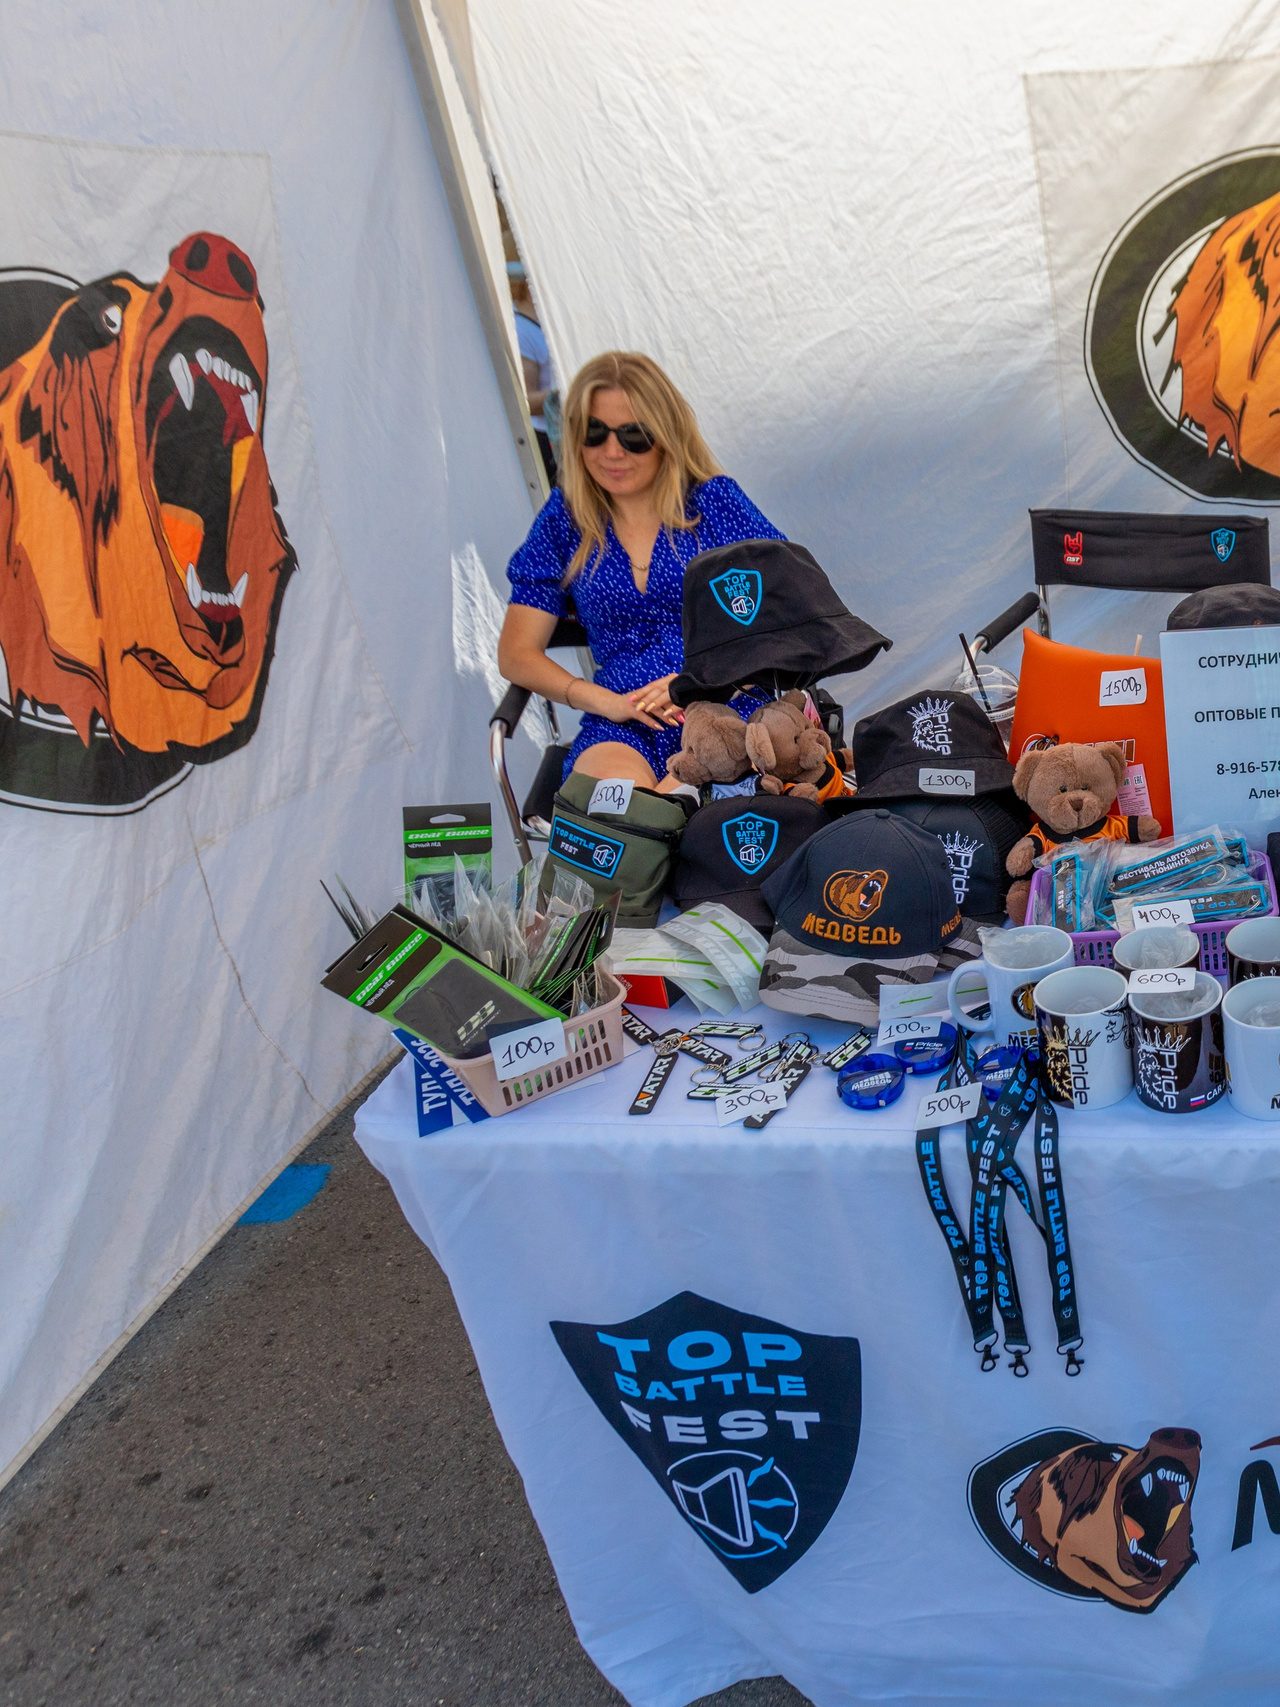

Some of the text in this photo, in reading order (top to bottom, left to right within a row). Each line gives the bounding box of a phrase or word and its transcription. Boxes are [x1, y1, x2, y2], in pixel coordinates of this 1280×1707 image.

[724, 574, 747, 585] TOP
[724, 582, 751, 594] BATTLE
[727, 588, 751, 599] FEST
[1194, 707, 1267, 724] ОПТОВЫЕ
[932, 712, 953, 756] Pride
[922, 774, 972, 789] 1300р
[555, 826, 596, 850] TOP BATTLE
[735, 830, 766, 838] BATTLE
[737, 821, 763, 831] TOP
[560, 841, 579, 855] FEST
[738, 836, 764, 844] FEST
[1117, 841, 1212, 882] ФЕСТИВАЛЬ АВТОЗВУКА
[1150, 857, 1191, 877] ТЮНИНГА
[1208, 900, 1237, 909] TOP
[801, 912, 902, 945] МЕДВЕДЬ
[1137, 972, 1187, 987] 600р
[882, 1021, 931, 1041] 100р
[502, 1036, 555, 1068] 100р
[1069, 1046, 1091, 1105] Pride
[1160, 1050, 1179, 1110] Pride
[724, 1089, 779, 1114] 300р
[924, 1094, 971, 1117] 500р
[1206, 1086, 1222, 1101] CAR
[978, 1124, 1001, 1186] FEST
[921, 1141, 964, 1249] TOP BATTLE
[974, 1190, 987, 1255] BATTLE
[1040, 1122, 1072, 1301] TOP BATTLE FEST
[988, 1205, 1006, 1267] BATTLE
[975, 1260, 988, 1299] TOP
[997, 1270, 1012, 1308] TOP
[596, 1330, 803, 1374] TOP
[614, 1371, 808, 1402] BATTLE
[620, 1400, 821, 1444] FEST
